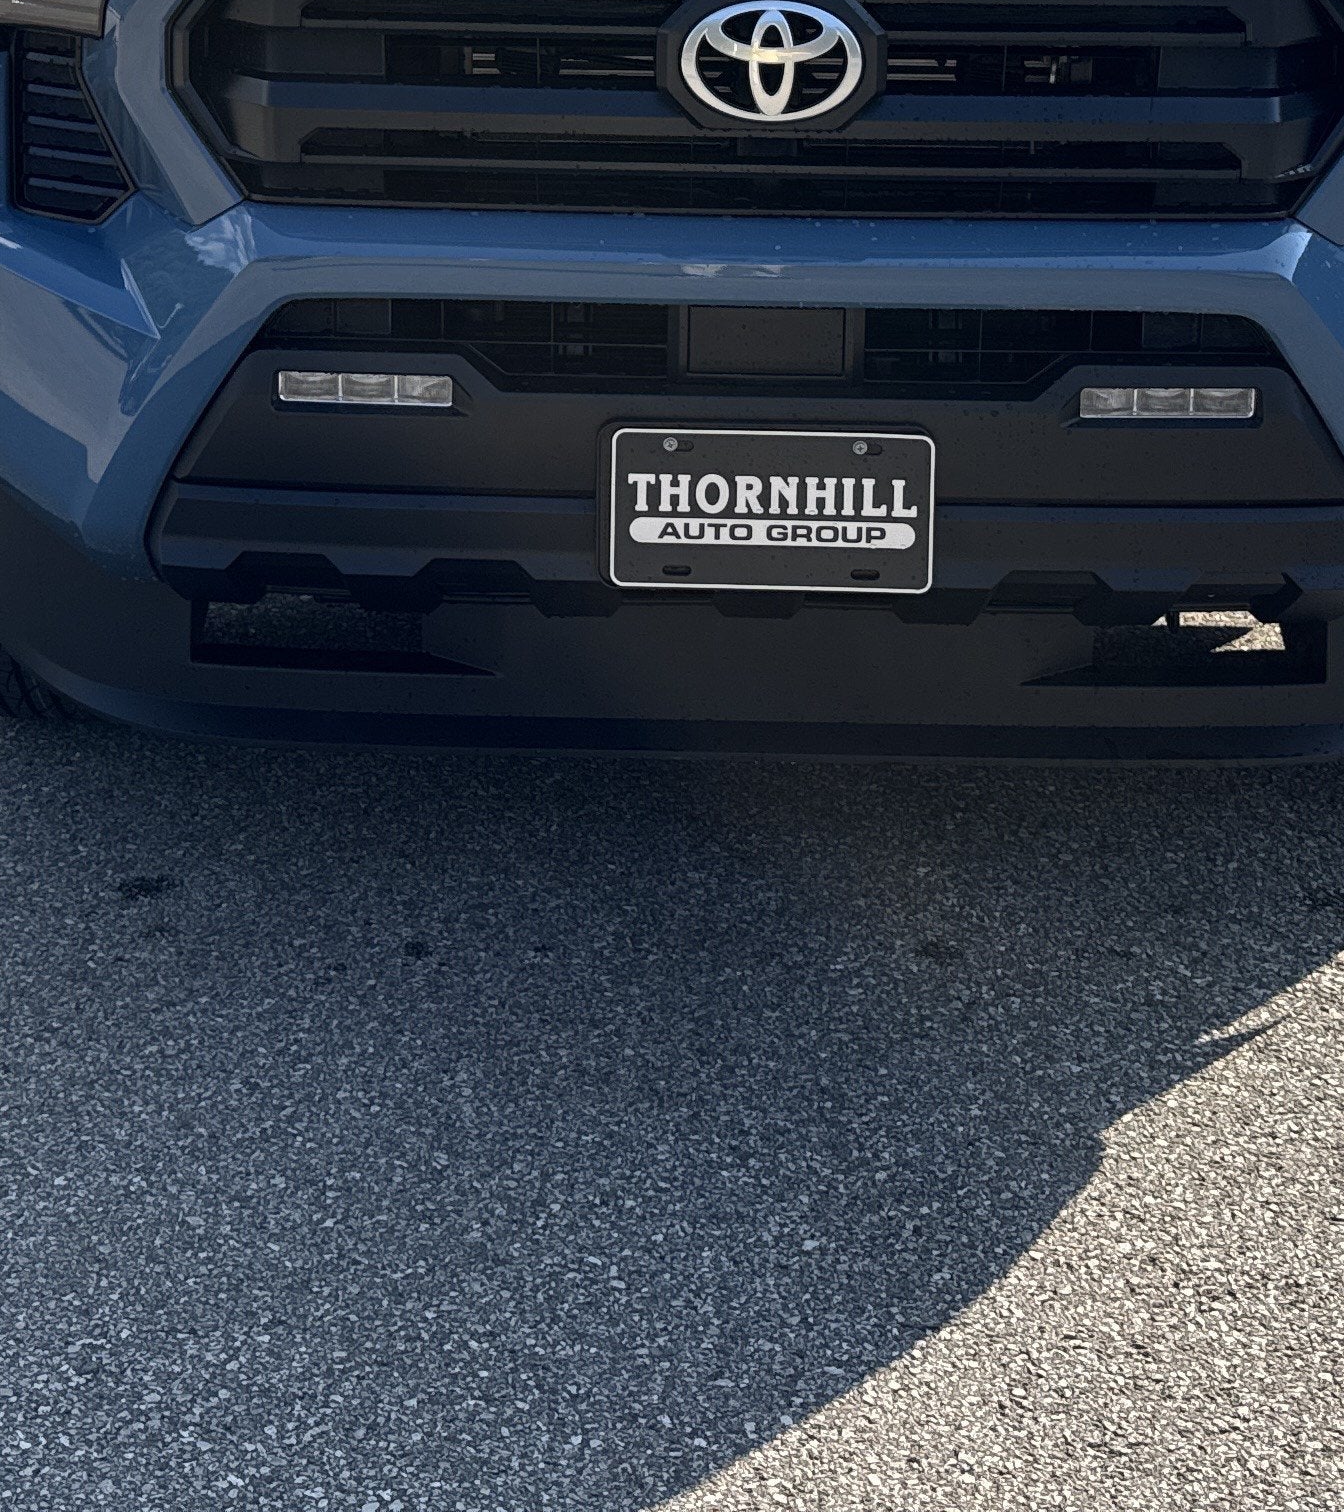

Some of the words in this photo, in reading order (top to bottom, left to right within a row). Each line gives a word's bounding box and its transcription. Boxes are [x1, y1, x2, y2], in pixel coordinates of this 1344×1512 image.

[627, 472, 918, 518] THORNHILL
[657, 521, 754, 542] AUTO
[765, 523, 887, 544] GROUP
